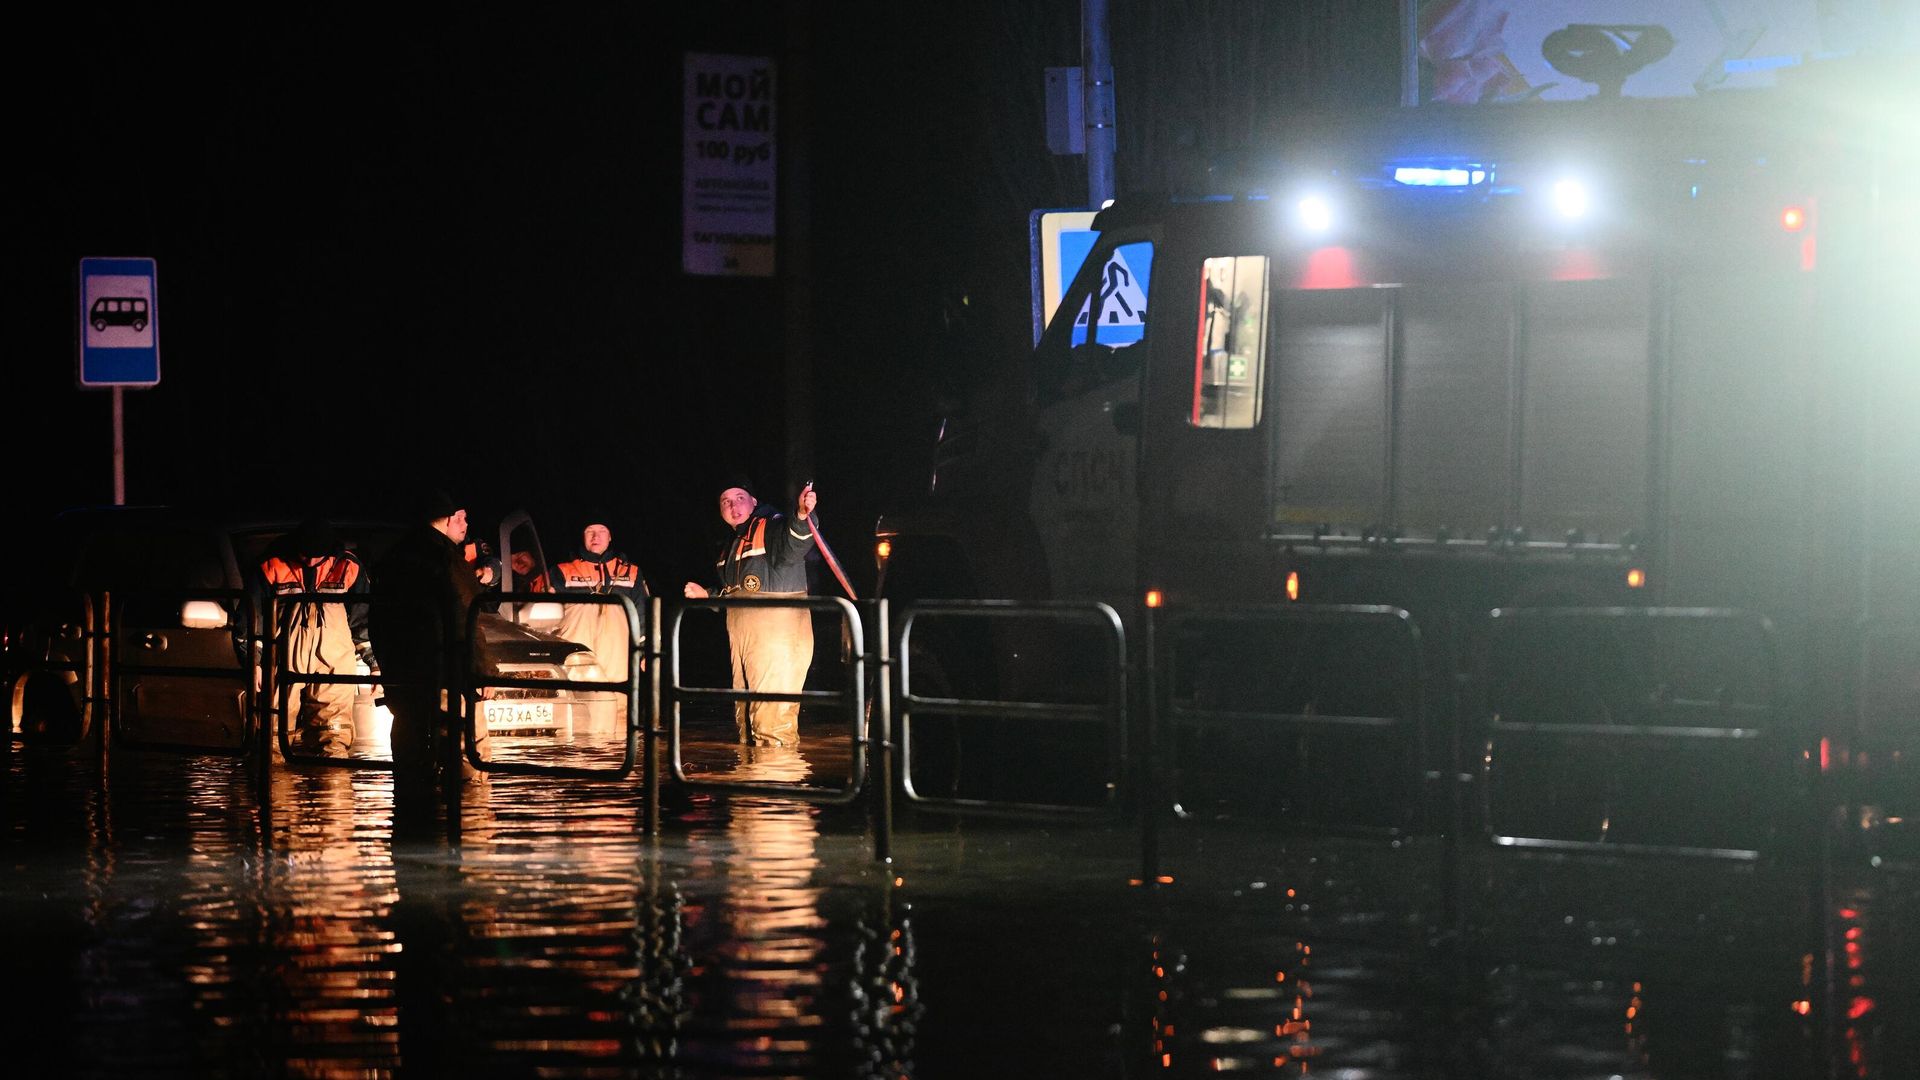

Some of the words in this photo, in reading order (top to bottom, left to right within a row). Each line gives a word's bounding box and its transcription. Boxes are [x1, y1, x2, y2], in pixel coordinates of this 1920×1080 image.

[697, 68, 771, 101] МОЙ
[696, 101, 770, 132] САМ
[696, 140, 730, 160] 100
[734, 142, 771, 166] руб
